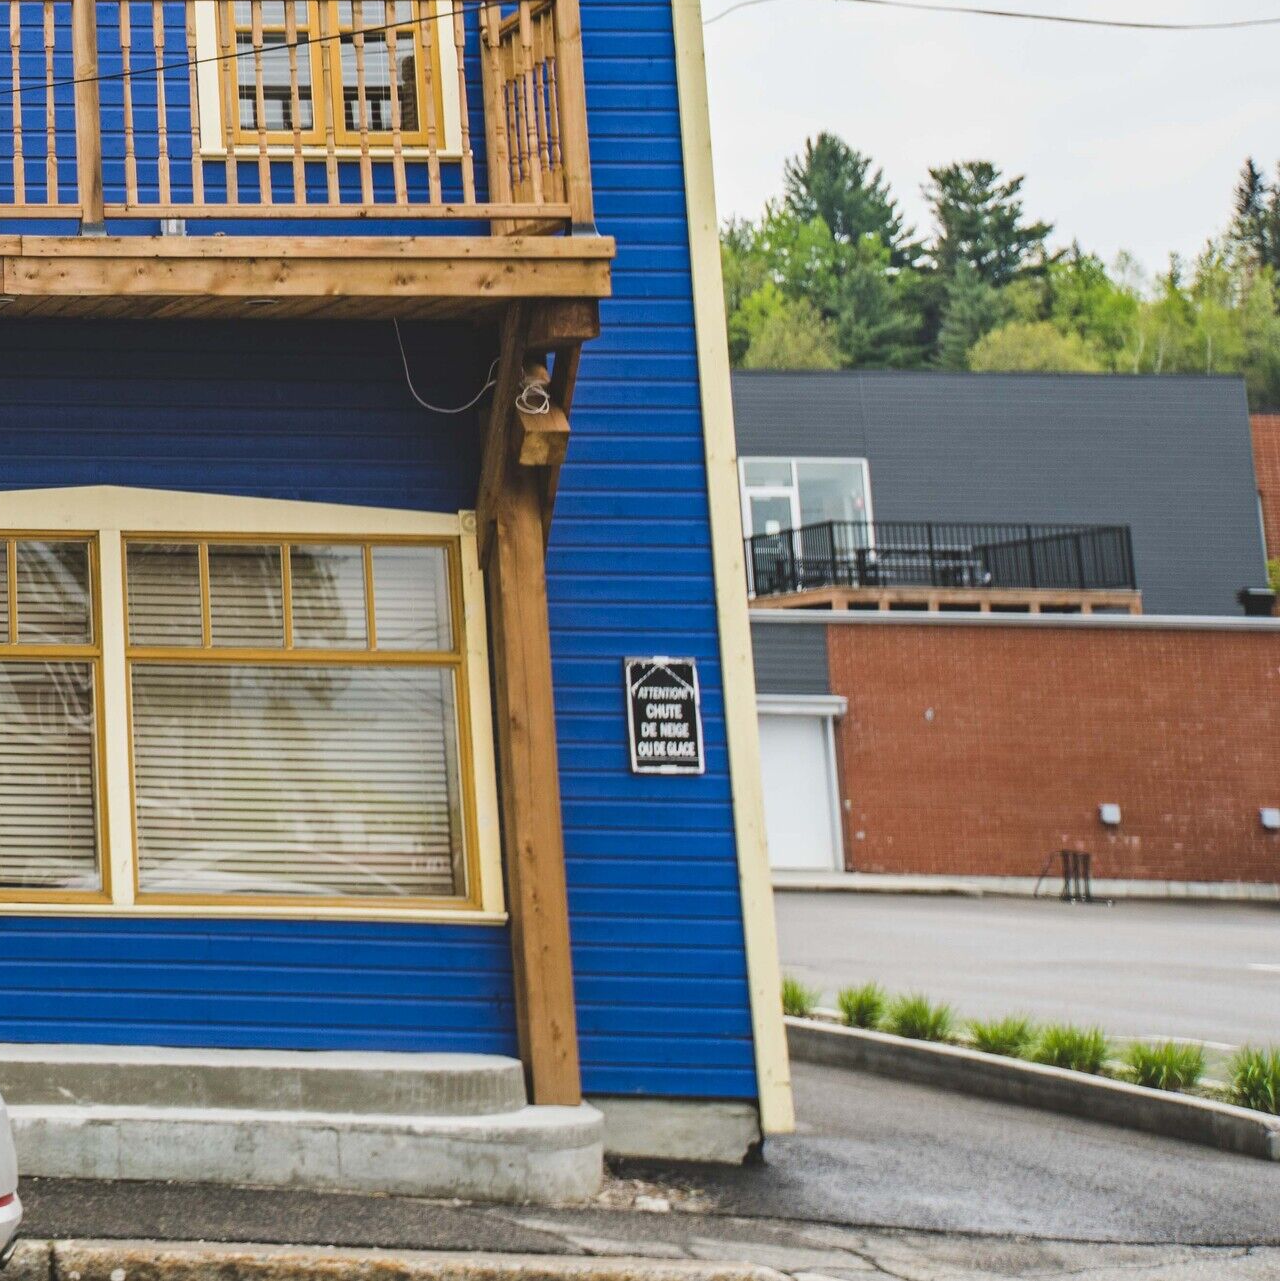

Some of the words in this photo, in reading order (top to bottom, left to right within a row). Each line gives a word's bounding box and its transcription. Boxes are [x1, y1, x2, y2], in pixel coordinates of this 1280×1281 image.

[645, 703, 683, 719] CHUTE
[641, 722, 657, 738] DE
[660, 722, 689, 738] NEIGE
[638, 741, 653, 757] OU
[653, 741, 666, 756] DE
[667, 741, 695, 756] GLACE
